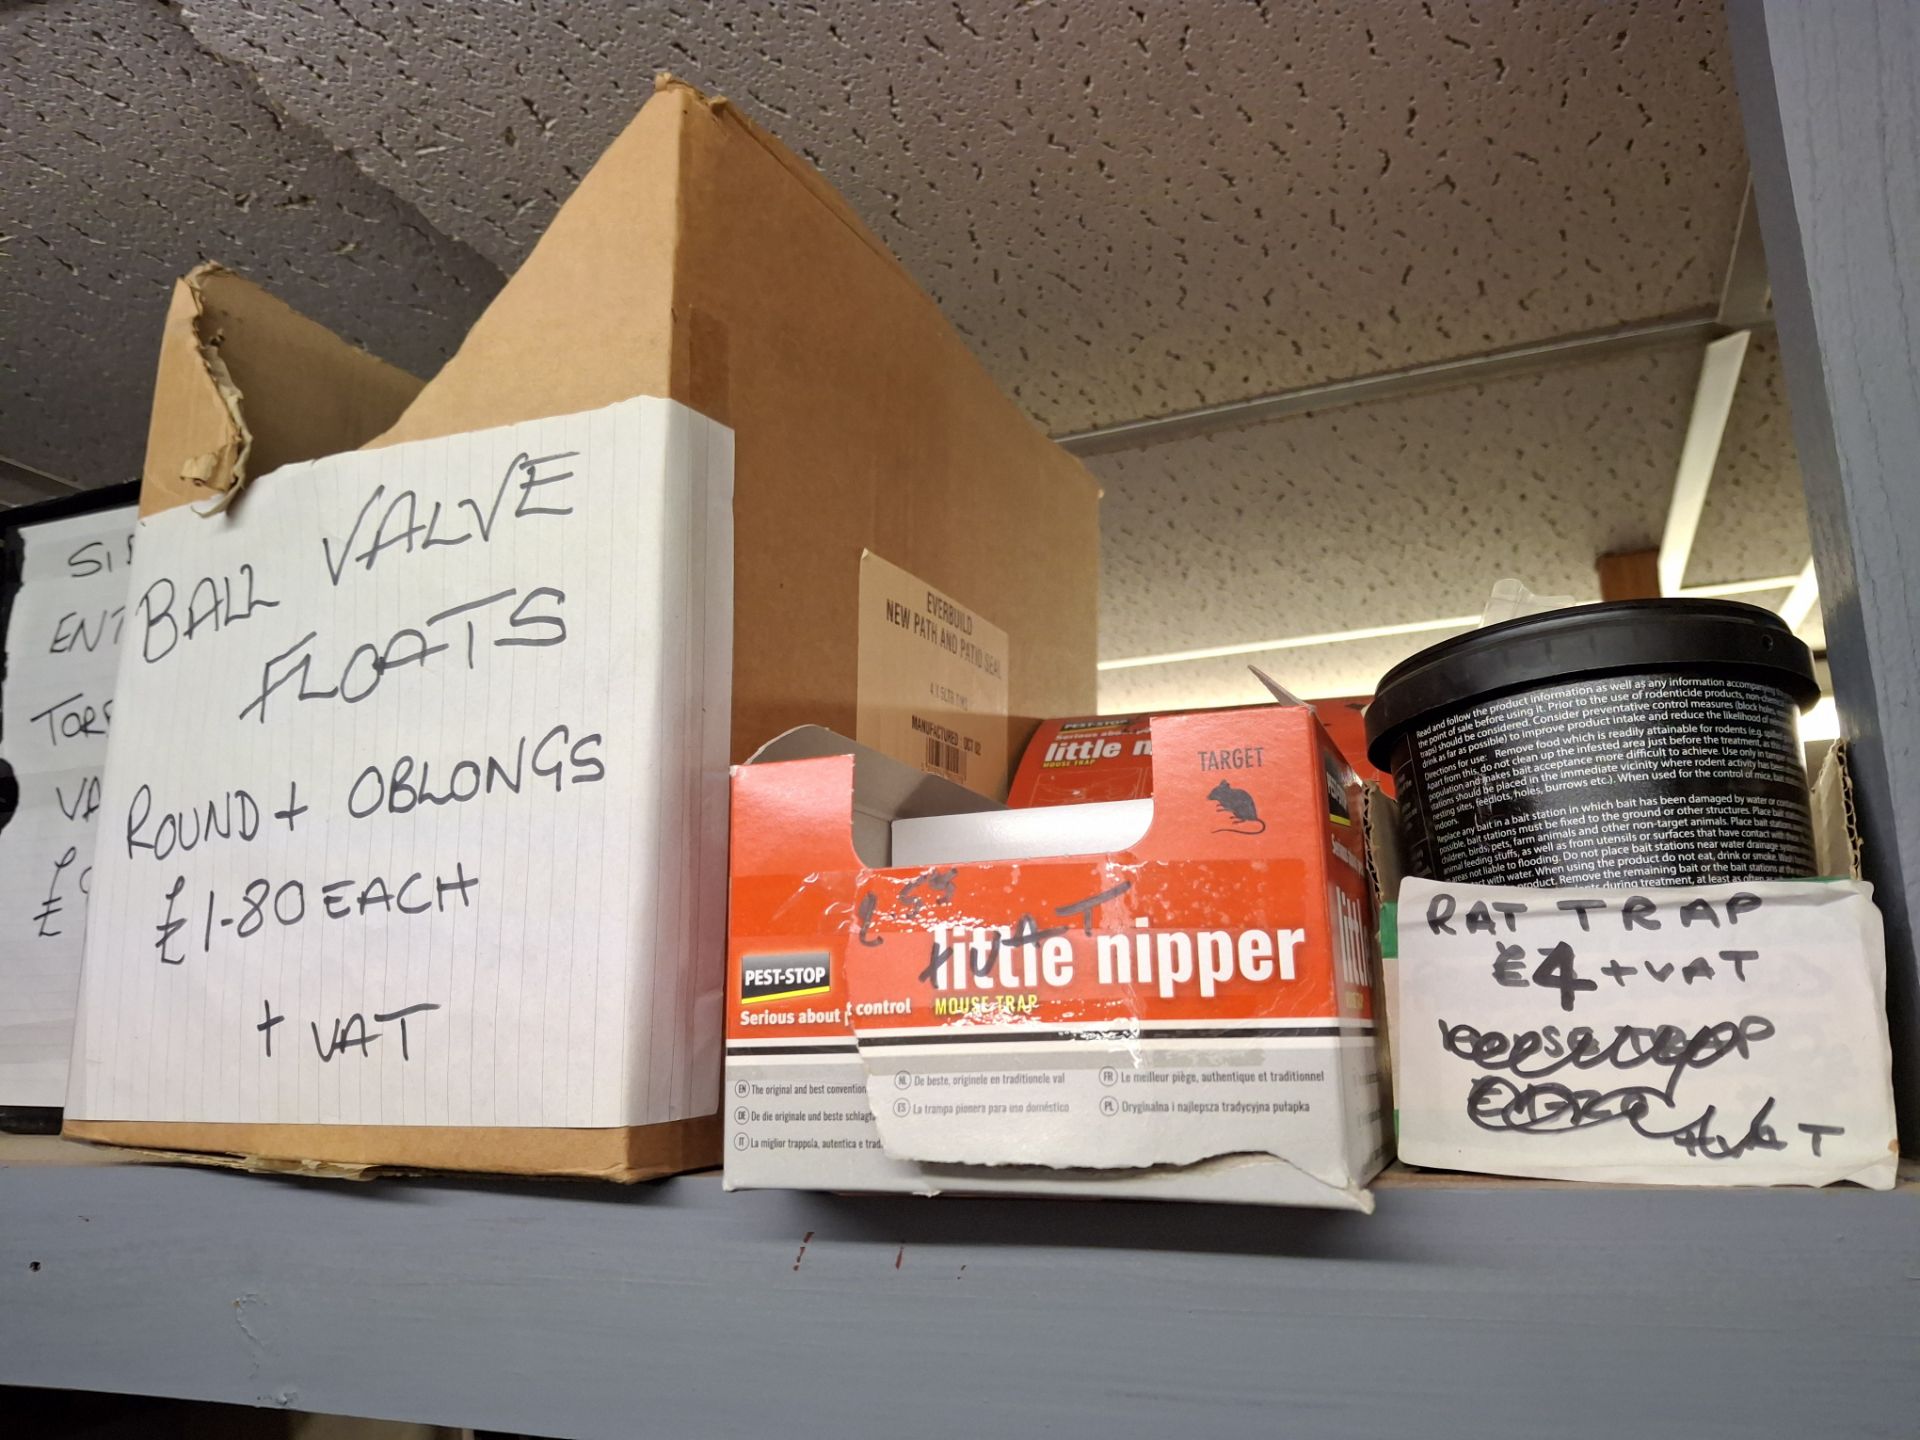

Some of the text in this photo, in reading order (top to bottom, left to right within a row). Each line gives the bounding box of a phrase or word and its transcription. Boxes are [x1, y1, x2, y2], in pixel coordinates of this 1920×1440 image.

[136, 451, 579, 663] BALL VALVE
[927, 591, 972, 636] EVERBUILD
[886, 598, 911, 630] NEW
[914, 612, 938, 645] PATH
[940, 627, 958, 654] AND
[960, 638, 982, 668] PATIO
[239, 586, 567, 723] FLOATS
[1530, 687, 1592, 703] information
[1610, 681, 1631, 691] well
[1648, 681, 1667, 689] any
[1669, 678, 1724, 687] information
[1644, 688, 1702, 698] rodenticide
[1522, 710, 1704, 738] improve product intake reduce
[1532, 712, 1579, 726] Consider
[1582, 703, 1649, 720] preventative
[1652, 699, 1688, 709] control
[1535, 737, 1560, 750] food
[1562, 732, 1595, 745] which
[1608, 726, 1644, 738] readily
[1646, 724, 1697, 734] attainable
[1576, 740, 1620, 754] infested
[1670, 735, 1701, 744] before
[1044, 739, 1122, 762] little
[1198, 747, 1264, 772] TARGET
[1533, 746, 1720, 772] acceptance difficult achieve.
[1560, 764, 1618, 778] immediate
[1620, 761, 1658, 771] vicinity
[1660, 758, 1692, 767] where
[1544, 769, 1676, 793] burrows When used
[127, 724, 607, 862] ROUND + OBLONGS
[1531, 807, 1566, 819] station
[1580, 799, 1613, 811] which
[1659, 795, 1686, 803] been
[1560, 814, 1585, 826] fixed
[1622, 806, 1660, 820] ground
[1537, 828, 1576, 841] animals
[1601, 822, 1629, 832] other
[1632, 818, 1688, 829] non-target
[1596, 828, 1716, 844] utensils surfaces that
[1518, 841, 1694, 867] flooding. place stations
[1566, 854, 1659, 871] using product
[1559, 865, 1676, 883] Remove remaining
[1639, 876, 1694, 886] treatment,
[323, 862, 479, 919] EACH
[1426, 891, 1763, 935] RAT TRAP
[933, 916, 1305, 999] little nipper
[745, 966, 826, 987] PEST-STOP
[740, 1009, 795, 1026] Serious
[798, 1008, 841, 1023] about
[856, 998, 912, 1016] control
[935, 994, 1038, 1015] MOUSE TRAP
[257, 1001, 440, 1062] + VAT
[914, 1075, 925, 1086] De
[952, 1074, 988, 1087] originele
[990, 1075, 1001, 1085] en
[1002, 1073, 1051, 1085] traditionele
[1052, 1072, 1066, 1084] val
[1121, 1071, 1131, 1083] Le
[1133, 1071, 1169, 1083] meilleur
[1201, 1070, 1256, 1085] authentique
[1258, 1071, 1268, 1082] et
[1270, 1070, 1325, 1082] traditionnel
[752, 1084, 764, 1095] The
[765, 1084, 793, 1097] original
[794, 1084, 807, 1095] and
[809, 1083, 825, 1095] best
[751, 1111, 761, 1122] De
[762, 1111, 774, 1122] die
[775, 1111, 806, 1124] originale
[808, 1111, 822, 1121] und
[823, 1111, 844, 1122] beste
[913, 1104, 922, 1115] La
[924, 1103, 953, 1117] trampa
[988, 1103, 1008, 1115] para
[1009, 1103, 1024, 1113] uso
[1121, 1101, 1169, 1114] Oryginalna
[1171, 1101, 1175, 1112] i
[1177, 1100, 1218, 1114] najlepsza
[1222, 1100, 1270, 1114] tradycyjna
[750, 1138, 759, 1148] La
[761, 1137, 785, 1150] miglior
[822, 1137, 857, 1148] autentica
[858, 1139, 864, 1148] e
